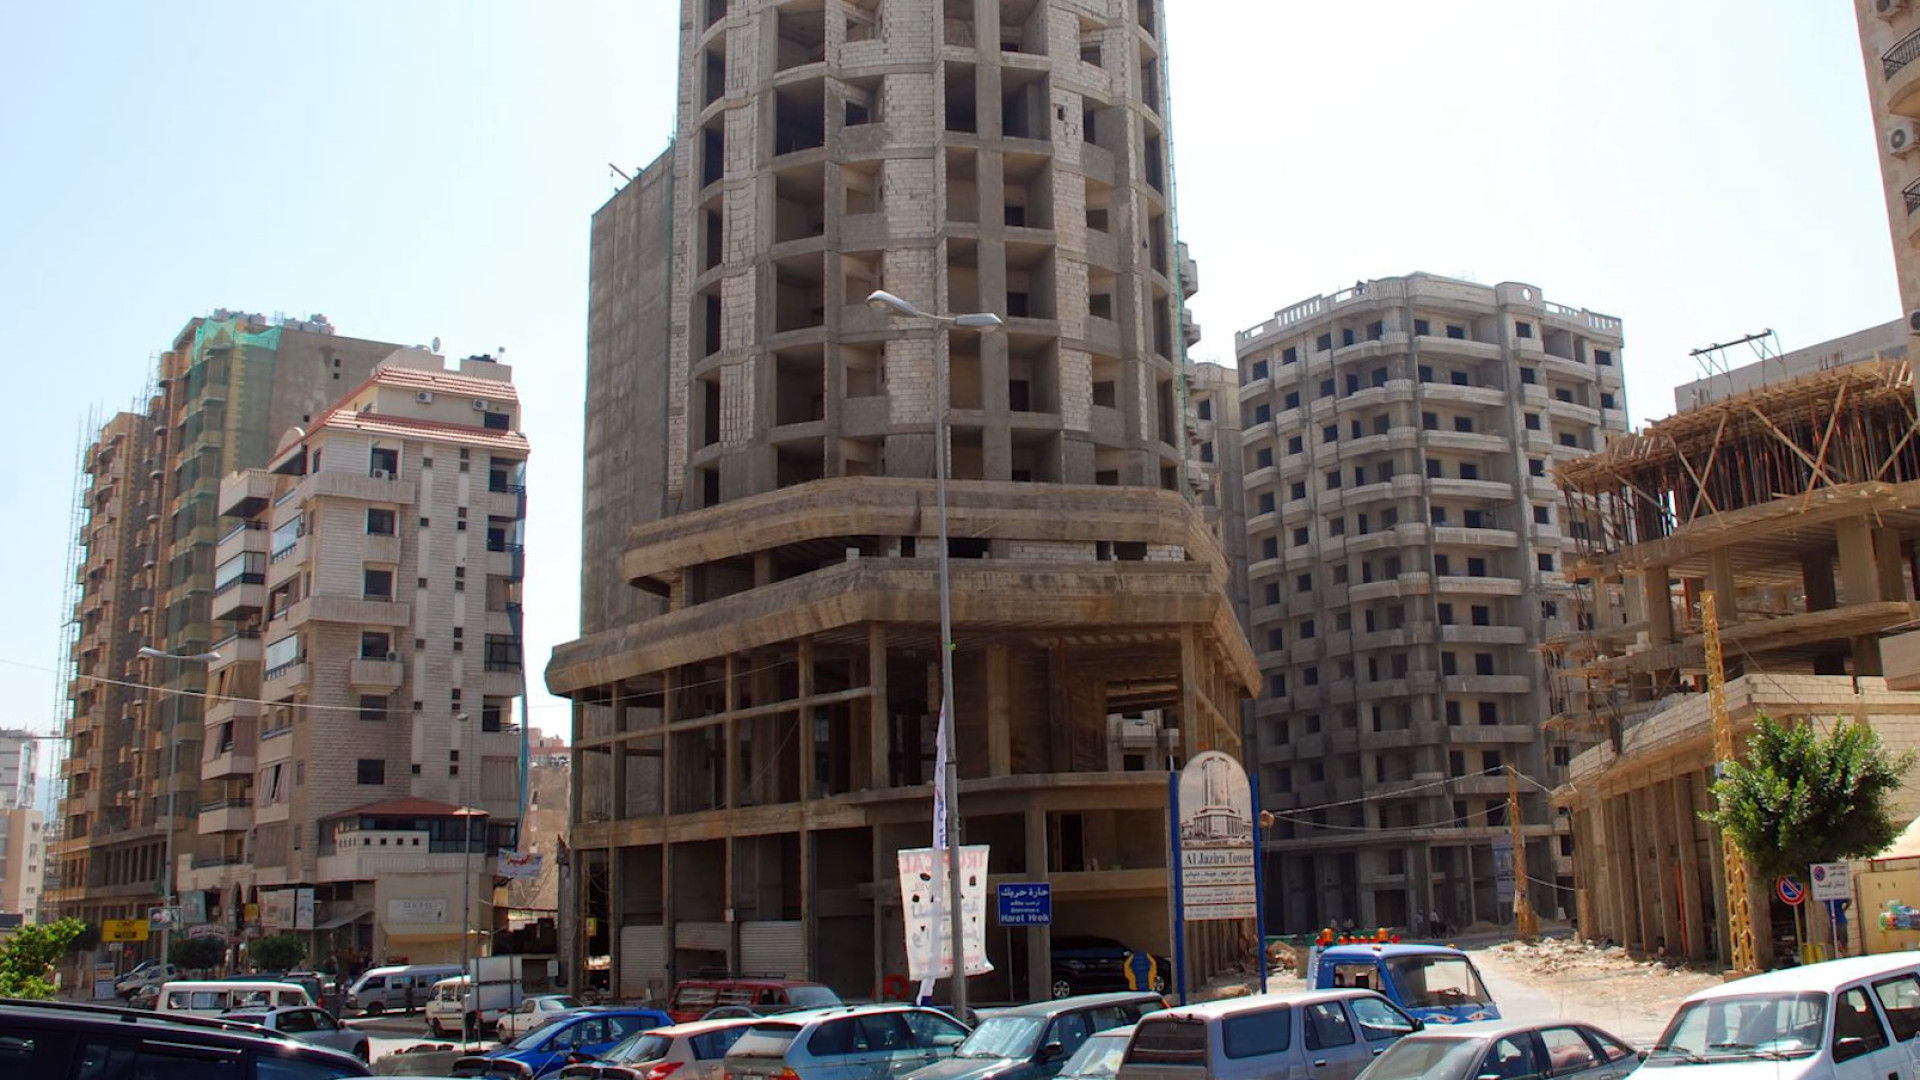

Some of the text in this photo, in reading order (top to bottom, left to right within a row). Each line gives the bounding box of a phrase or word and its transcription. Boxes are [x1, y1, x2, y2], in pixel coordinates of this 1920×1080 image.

[1185, 852, 1252, 865] Al Jazira Tower
[1000, 914, 1049, 922] Haret Hreik
